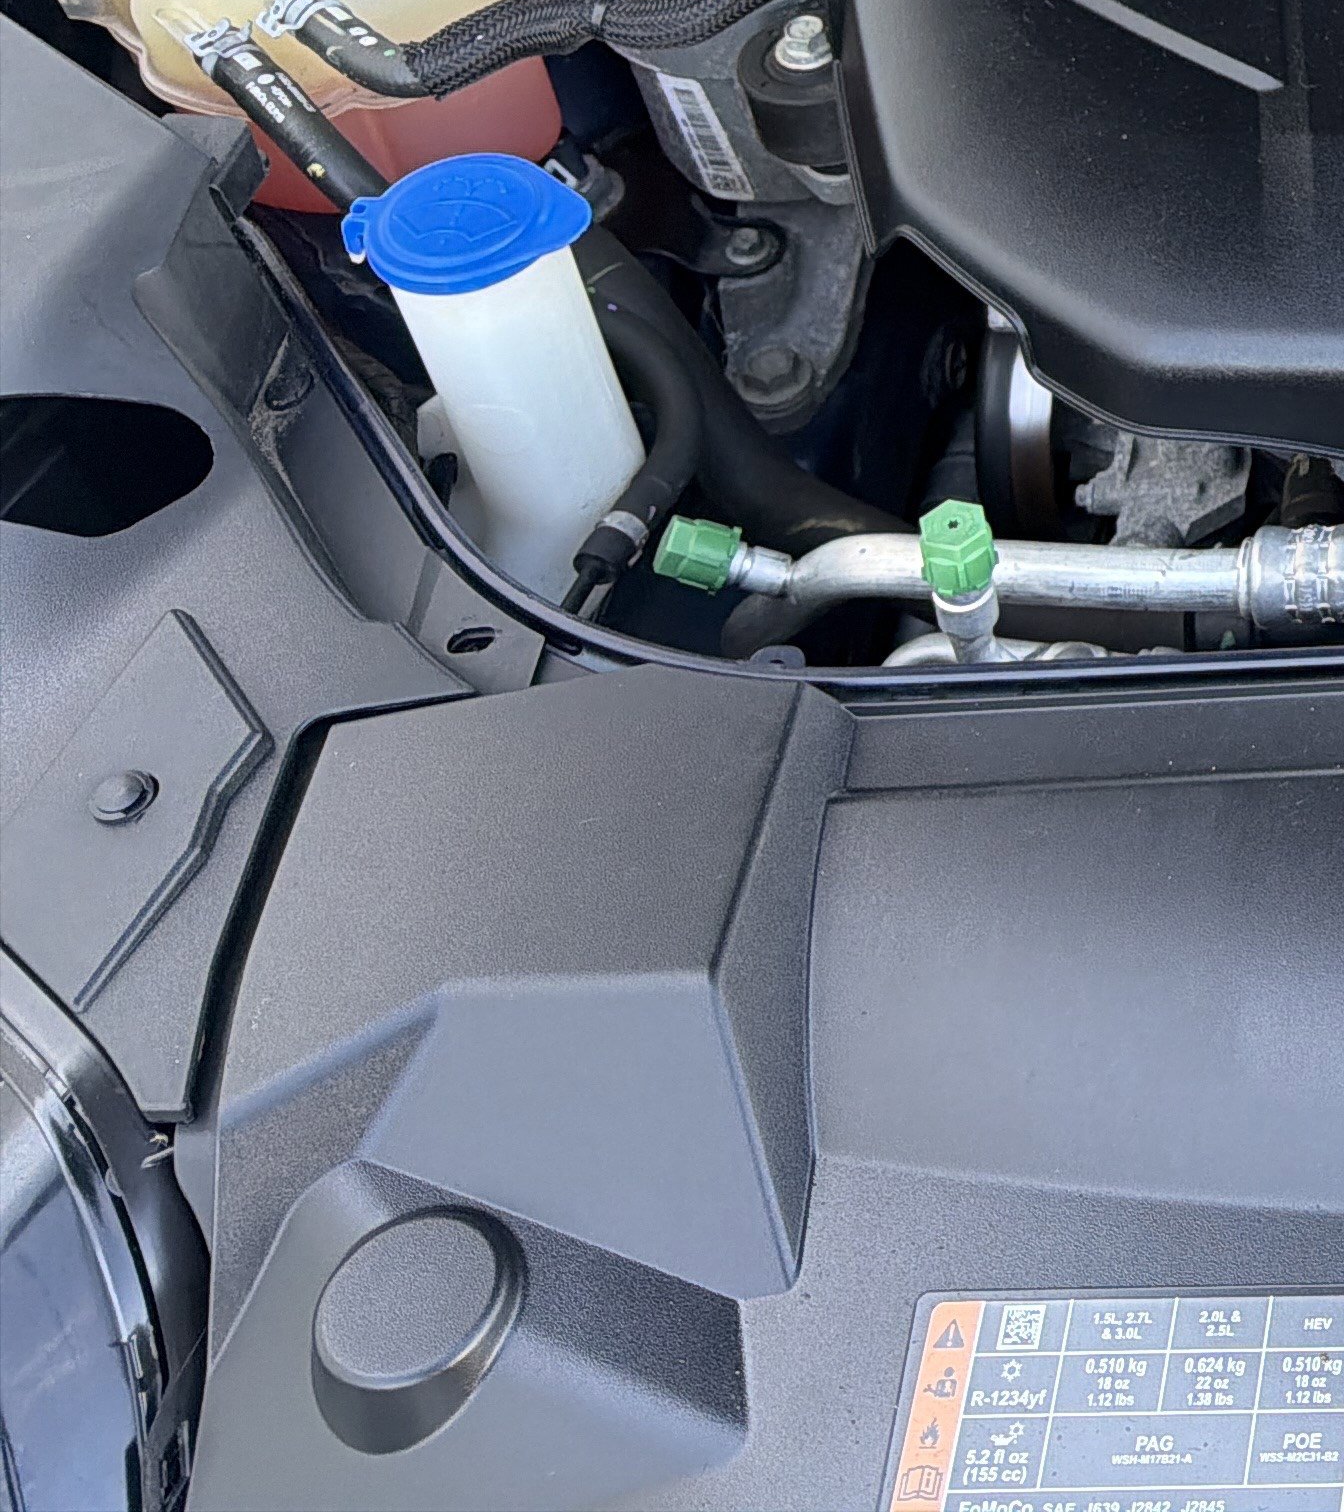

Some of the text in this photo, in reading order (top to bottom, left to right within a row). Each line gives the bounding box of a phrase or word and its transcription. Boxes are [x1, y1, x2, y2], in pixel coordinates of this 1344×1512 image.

[1093, 1312, 1152, 1326] 1.5L, 2.7L
[1199, 1310, 1241, 1323] 2.0L &
[1303, 1317, 1333, 1330] HEV
[1101, 1328, 1142, 1340] & 3.0L
[1205, 1325, 1234, 1337] 2.5L
[1085, 1358, 1147, 1377] 0.510 kg
[1184, 1357, 1246, 1377] 0.624 kg
[1282, 1357, 1342, 1376] 0.510 kg
[1097, 1377, 1130, 1390] 18 oz
[1195, 1376, 1229, 1390] 22 oz
[1294, 1375, 1327, 1388] 18 oz
[970, 1389, 1047, 1409] R-1234yf
[1087, 1392, 1135, 1407] 1.12 lbs
[1186, 1392, 1234, 1406] 1.38 lbs
[1285, 1390, 1332, 1404] 1.12 lbs
[1135, 1434, 1174, 1452] PAG
[1283, 1432, 1323, 1450] POE
[965, 1448, 1029, 1465] 5.2 fl oz
[962, 1465, 1028, 1486] (155 cc)
